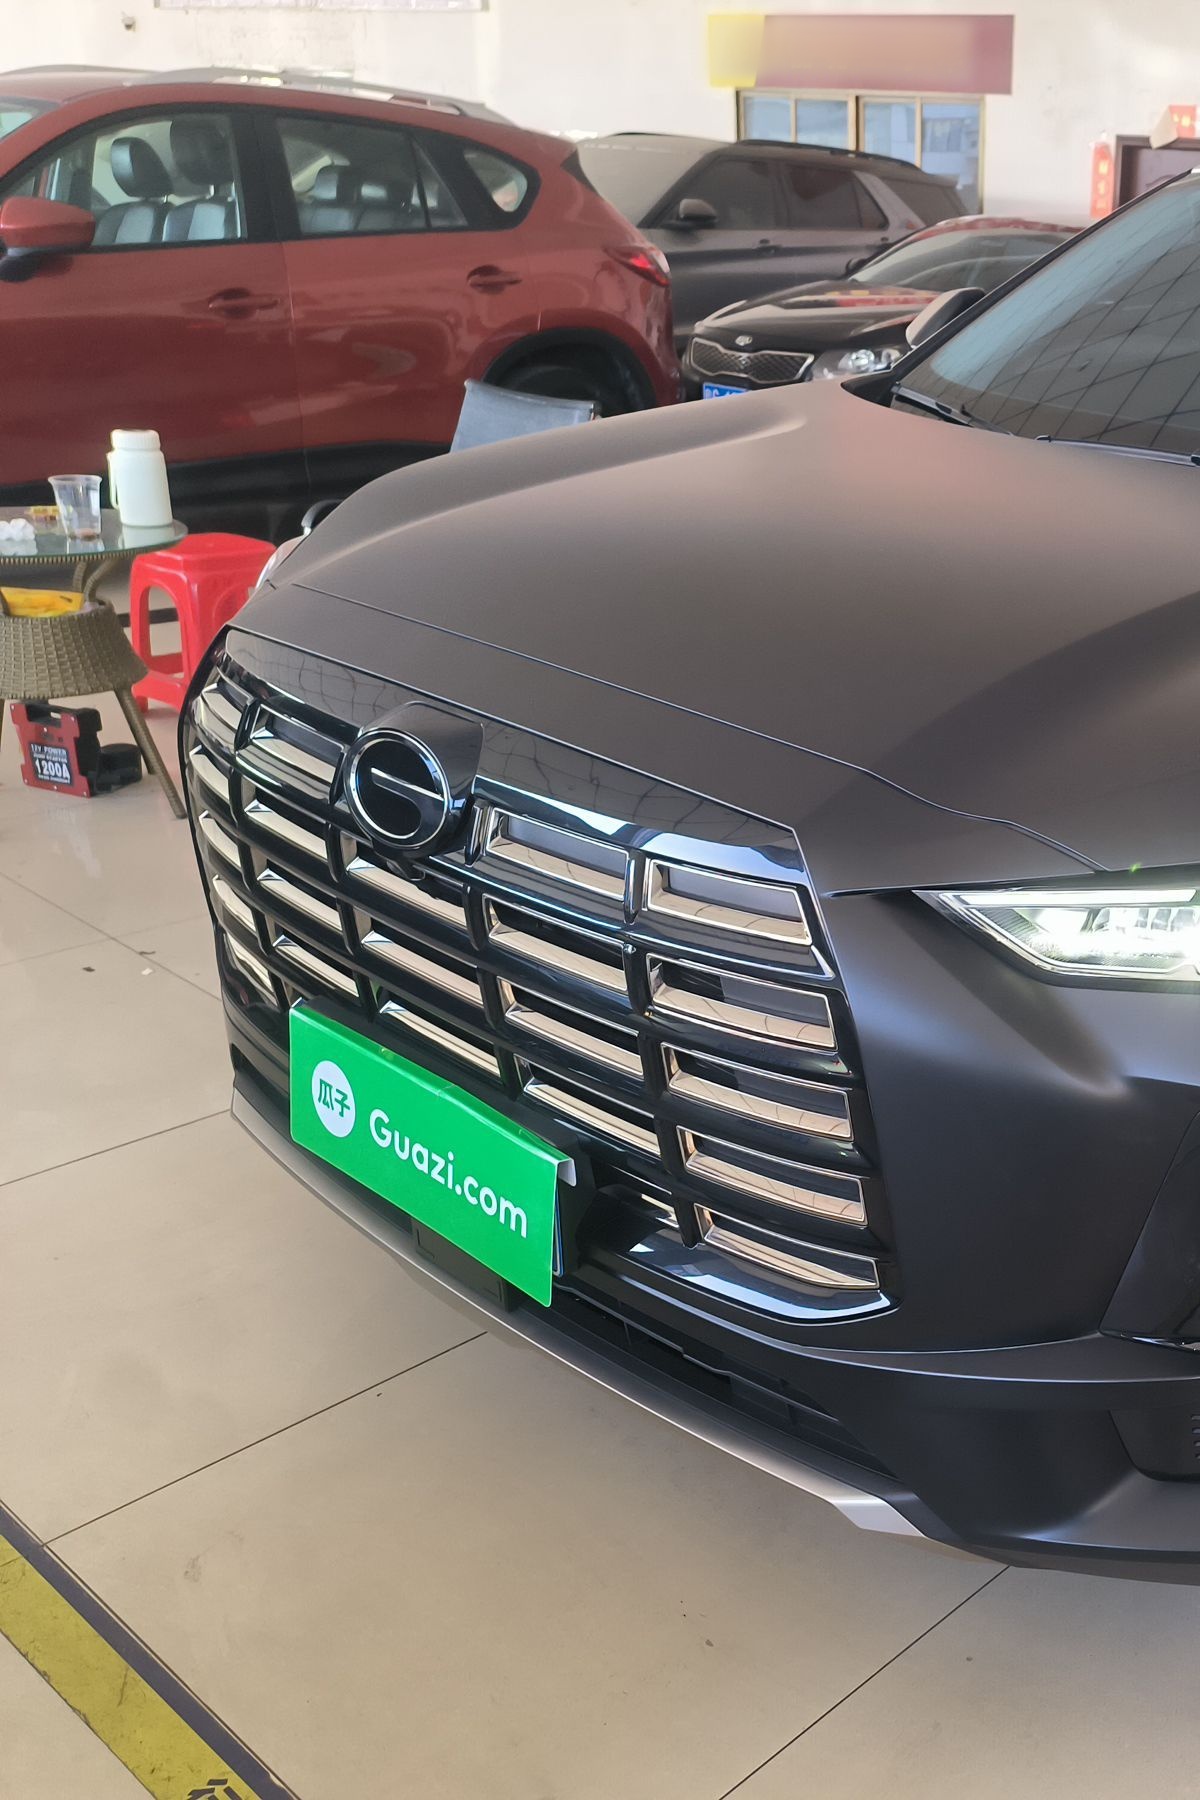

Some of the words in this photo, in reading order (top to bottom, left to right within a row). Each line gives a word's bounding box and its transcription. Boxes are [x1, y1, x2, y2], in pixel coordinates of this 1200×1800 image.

[35, 759, 70, 780] 1200A
[318, 1078, 351, 1117] 瓜子
[369, 1108, 528, 1239] Guazi.com
